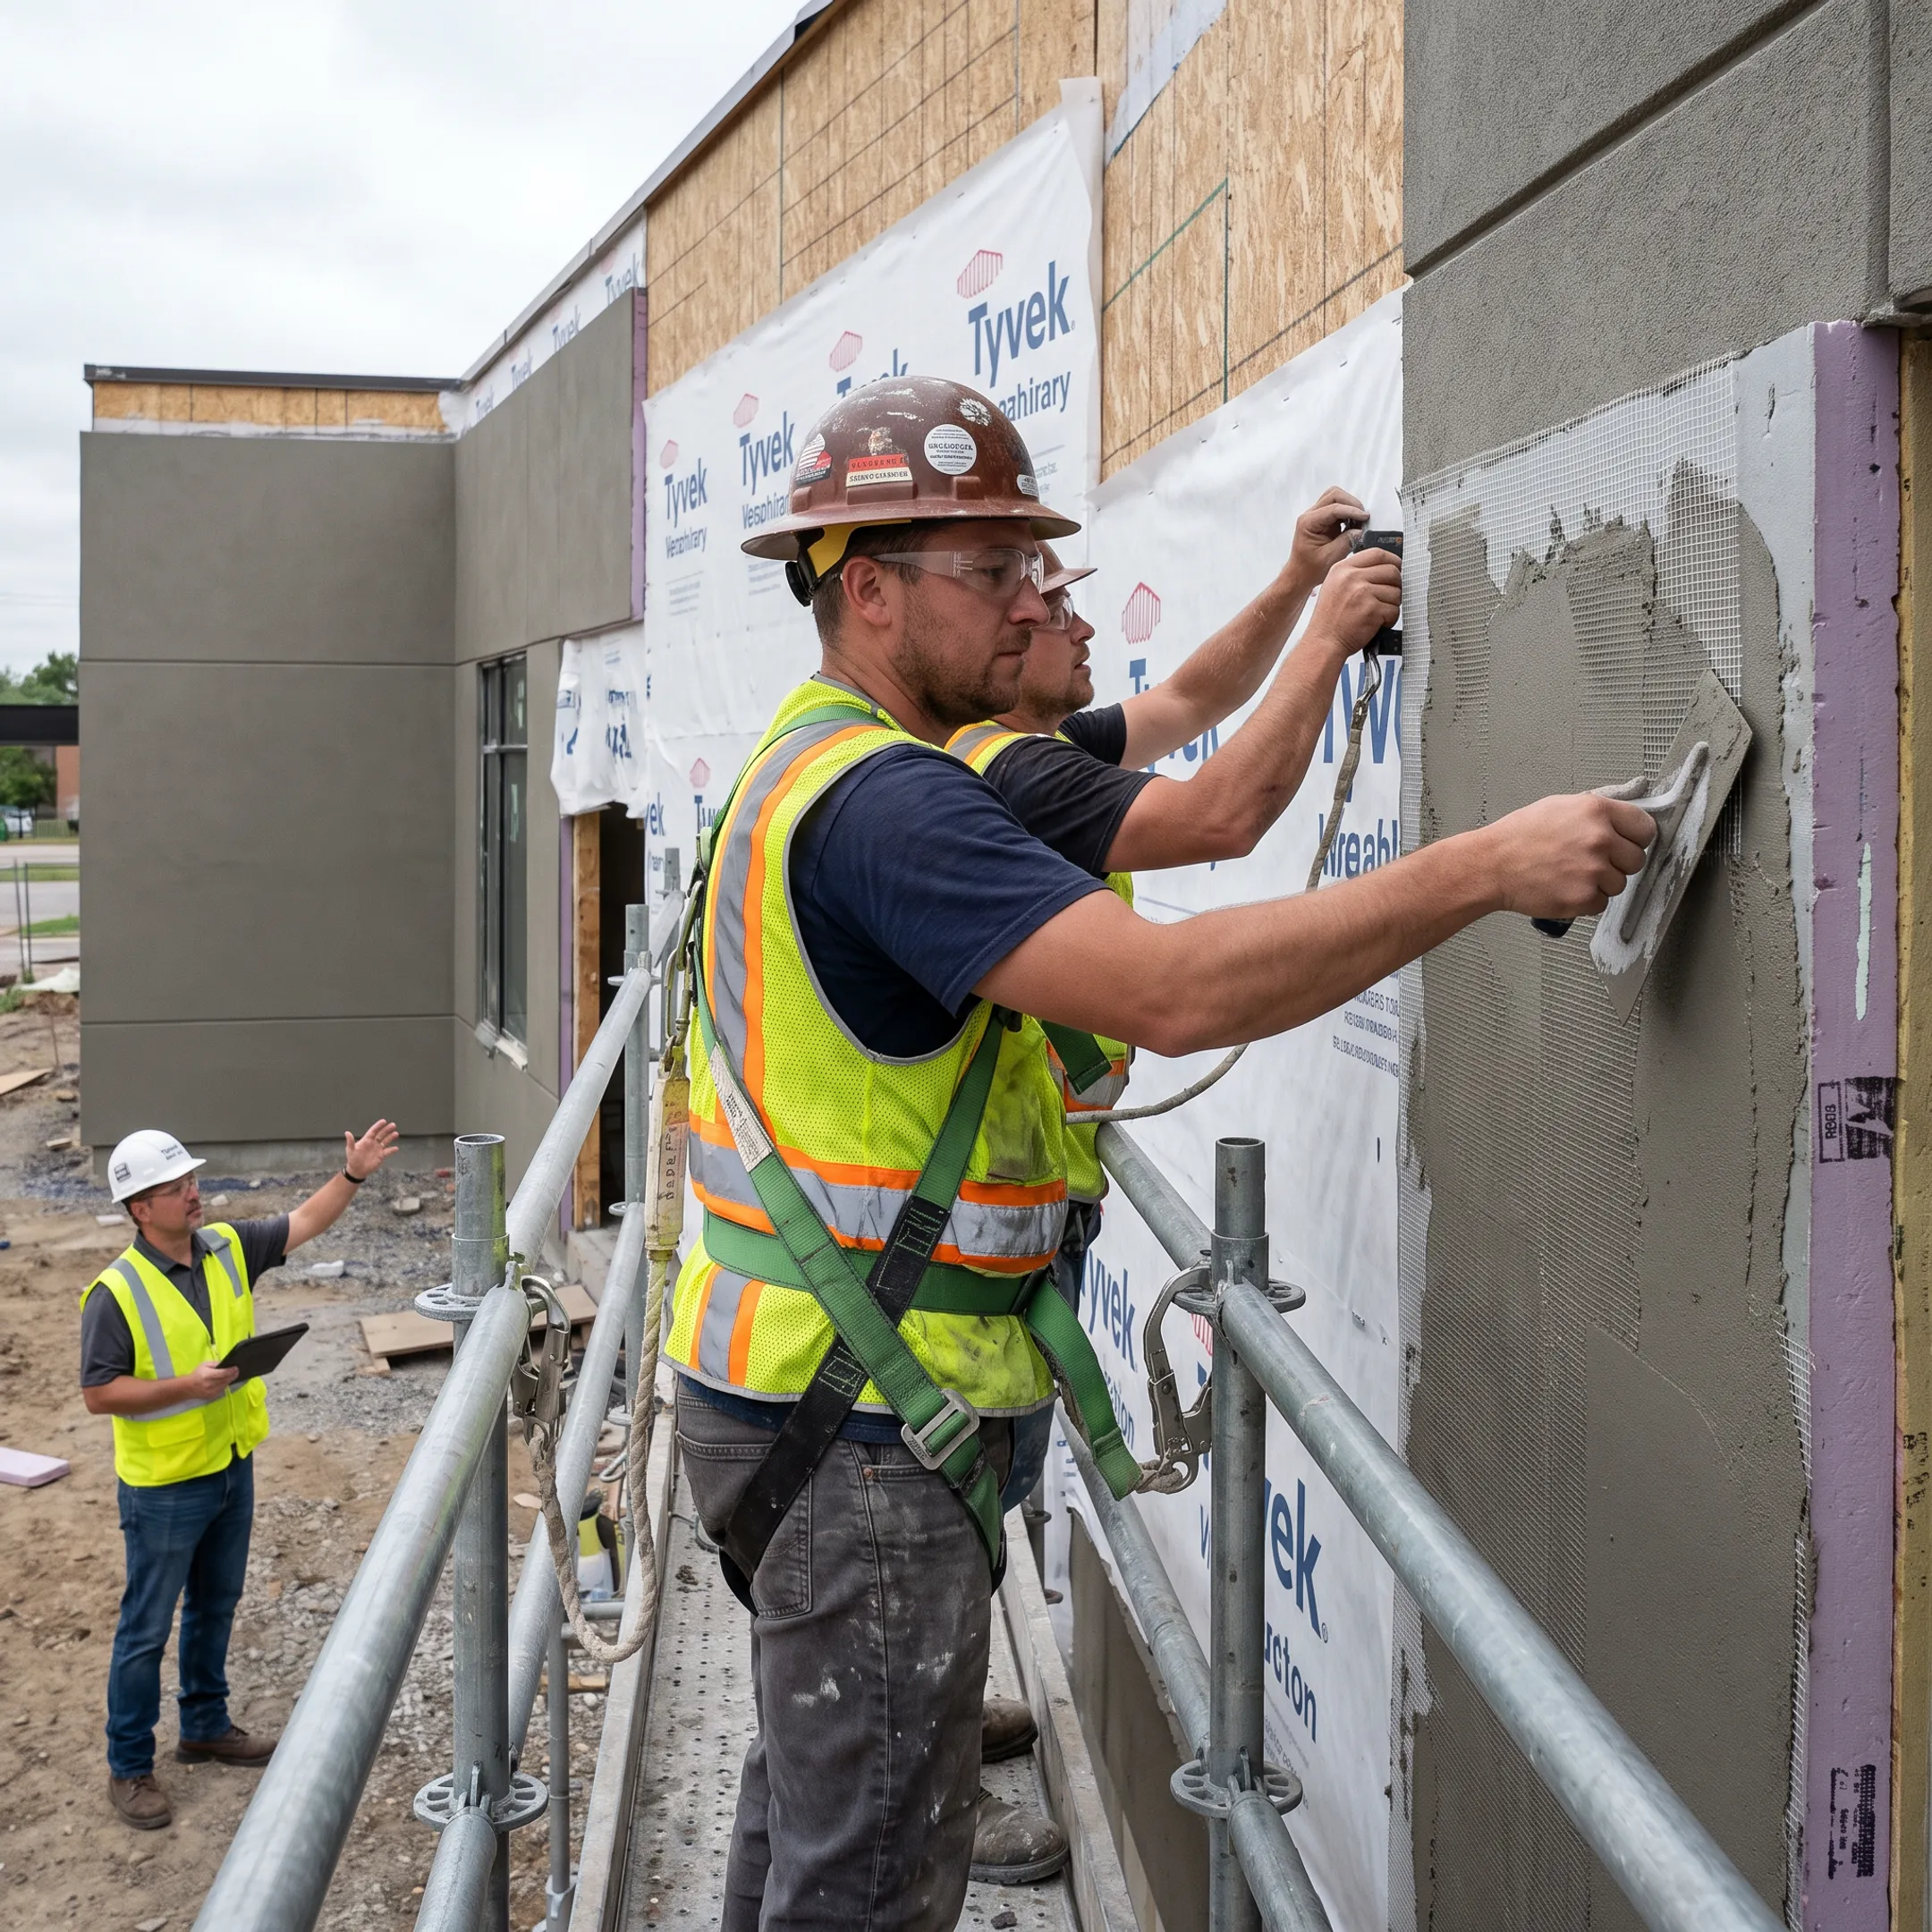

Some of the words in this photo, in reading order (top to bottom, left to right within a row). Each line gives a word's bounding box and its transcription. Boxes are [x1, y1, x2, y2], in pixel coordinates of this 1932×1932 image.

[968, 260, 1072, 387] Tyvek
[665, 458, 708, 529] Tyvek
[740, 411, 795, 496] Tyvek
[1080, 1249, 1136, 1372] yvek
